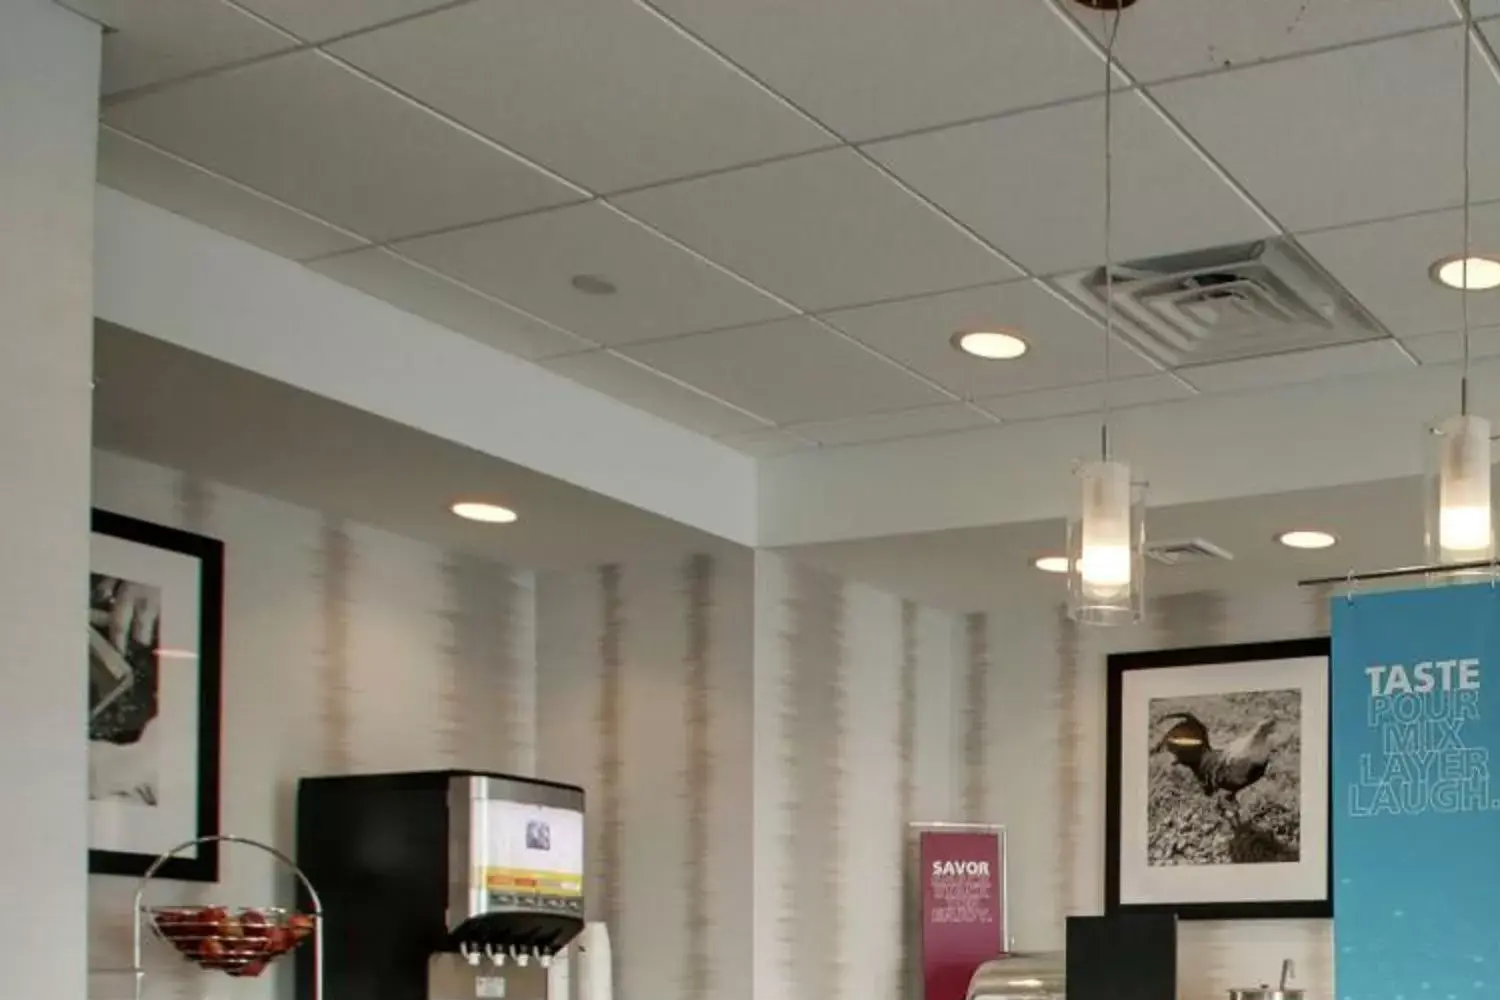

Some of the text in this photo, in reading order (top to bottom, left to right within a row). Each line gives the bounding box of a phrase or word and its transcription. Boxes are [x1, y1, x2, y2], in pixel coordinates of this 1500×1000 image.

[1365, 659, 1480, 696] TASTE
[1368, 689, 1480, 727] POUR
[1382, 718, 1465, 755] MIX
[1360, 748, 1490, 787] LAYER
[1349, 780, 1500, 816] LAUGH.
[932, 861, 990, 875] SAVOR
